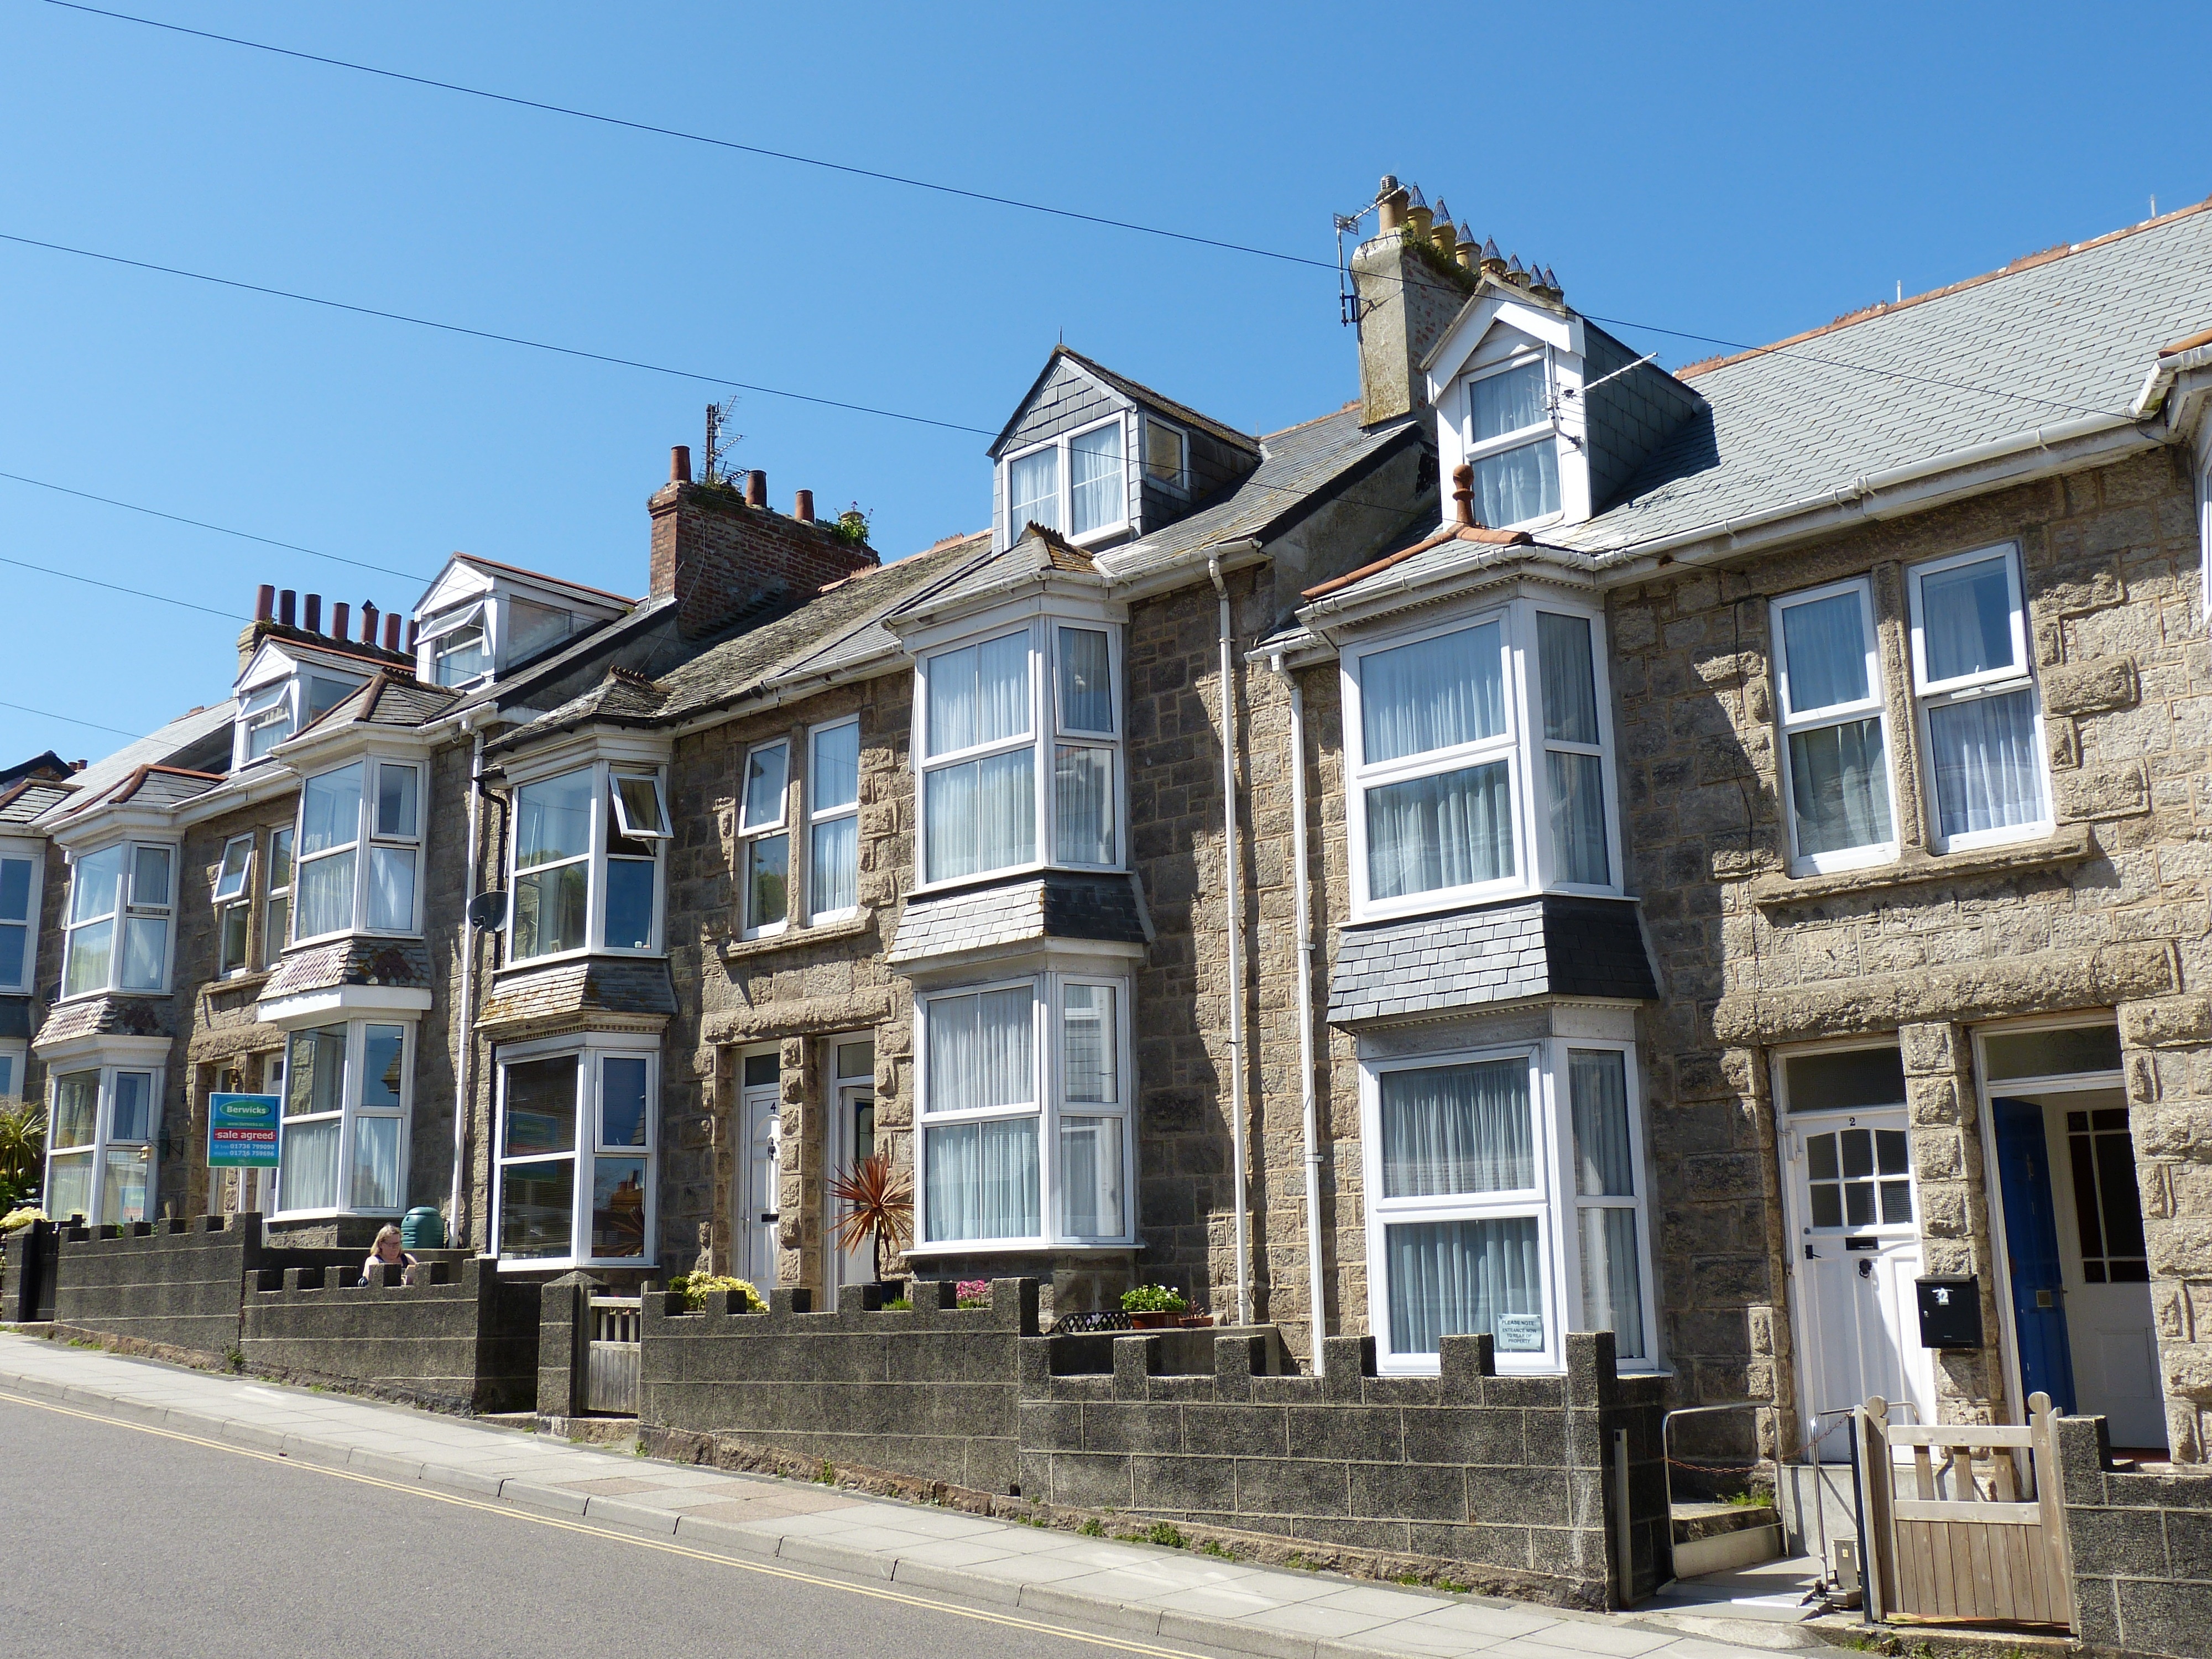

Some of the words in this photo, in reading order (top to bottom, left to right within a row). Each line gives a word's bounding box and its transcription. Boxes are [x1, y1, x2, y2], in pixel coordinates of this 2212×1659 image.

[770, 1102, 776, 1113] 4
[1849, 1117, 1856, 1126] 2
[217, 1130, 238, 1139] sale
[241, 1131, 273, 1140] agreed
